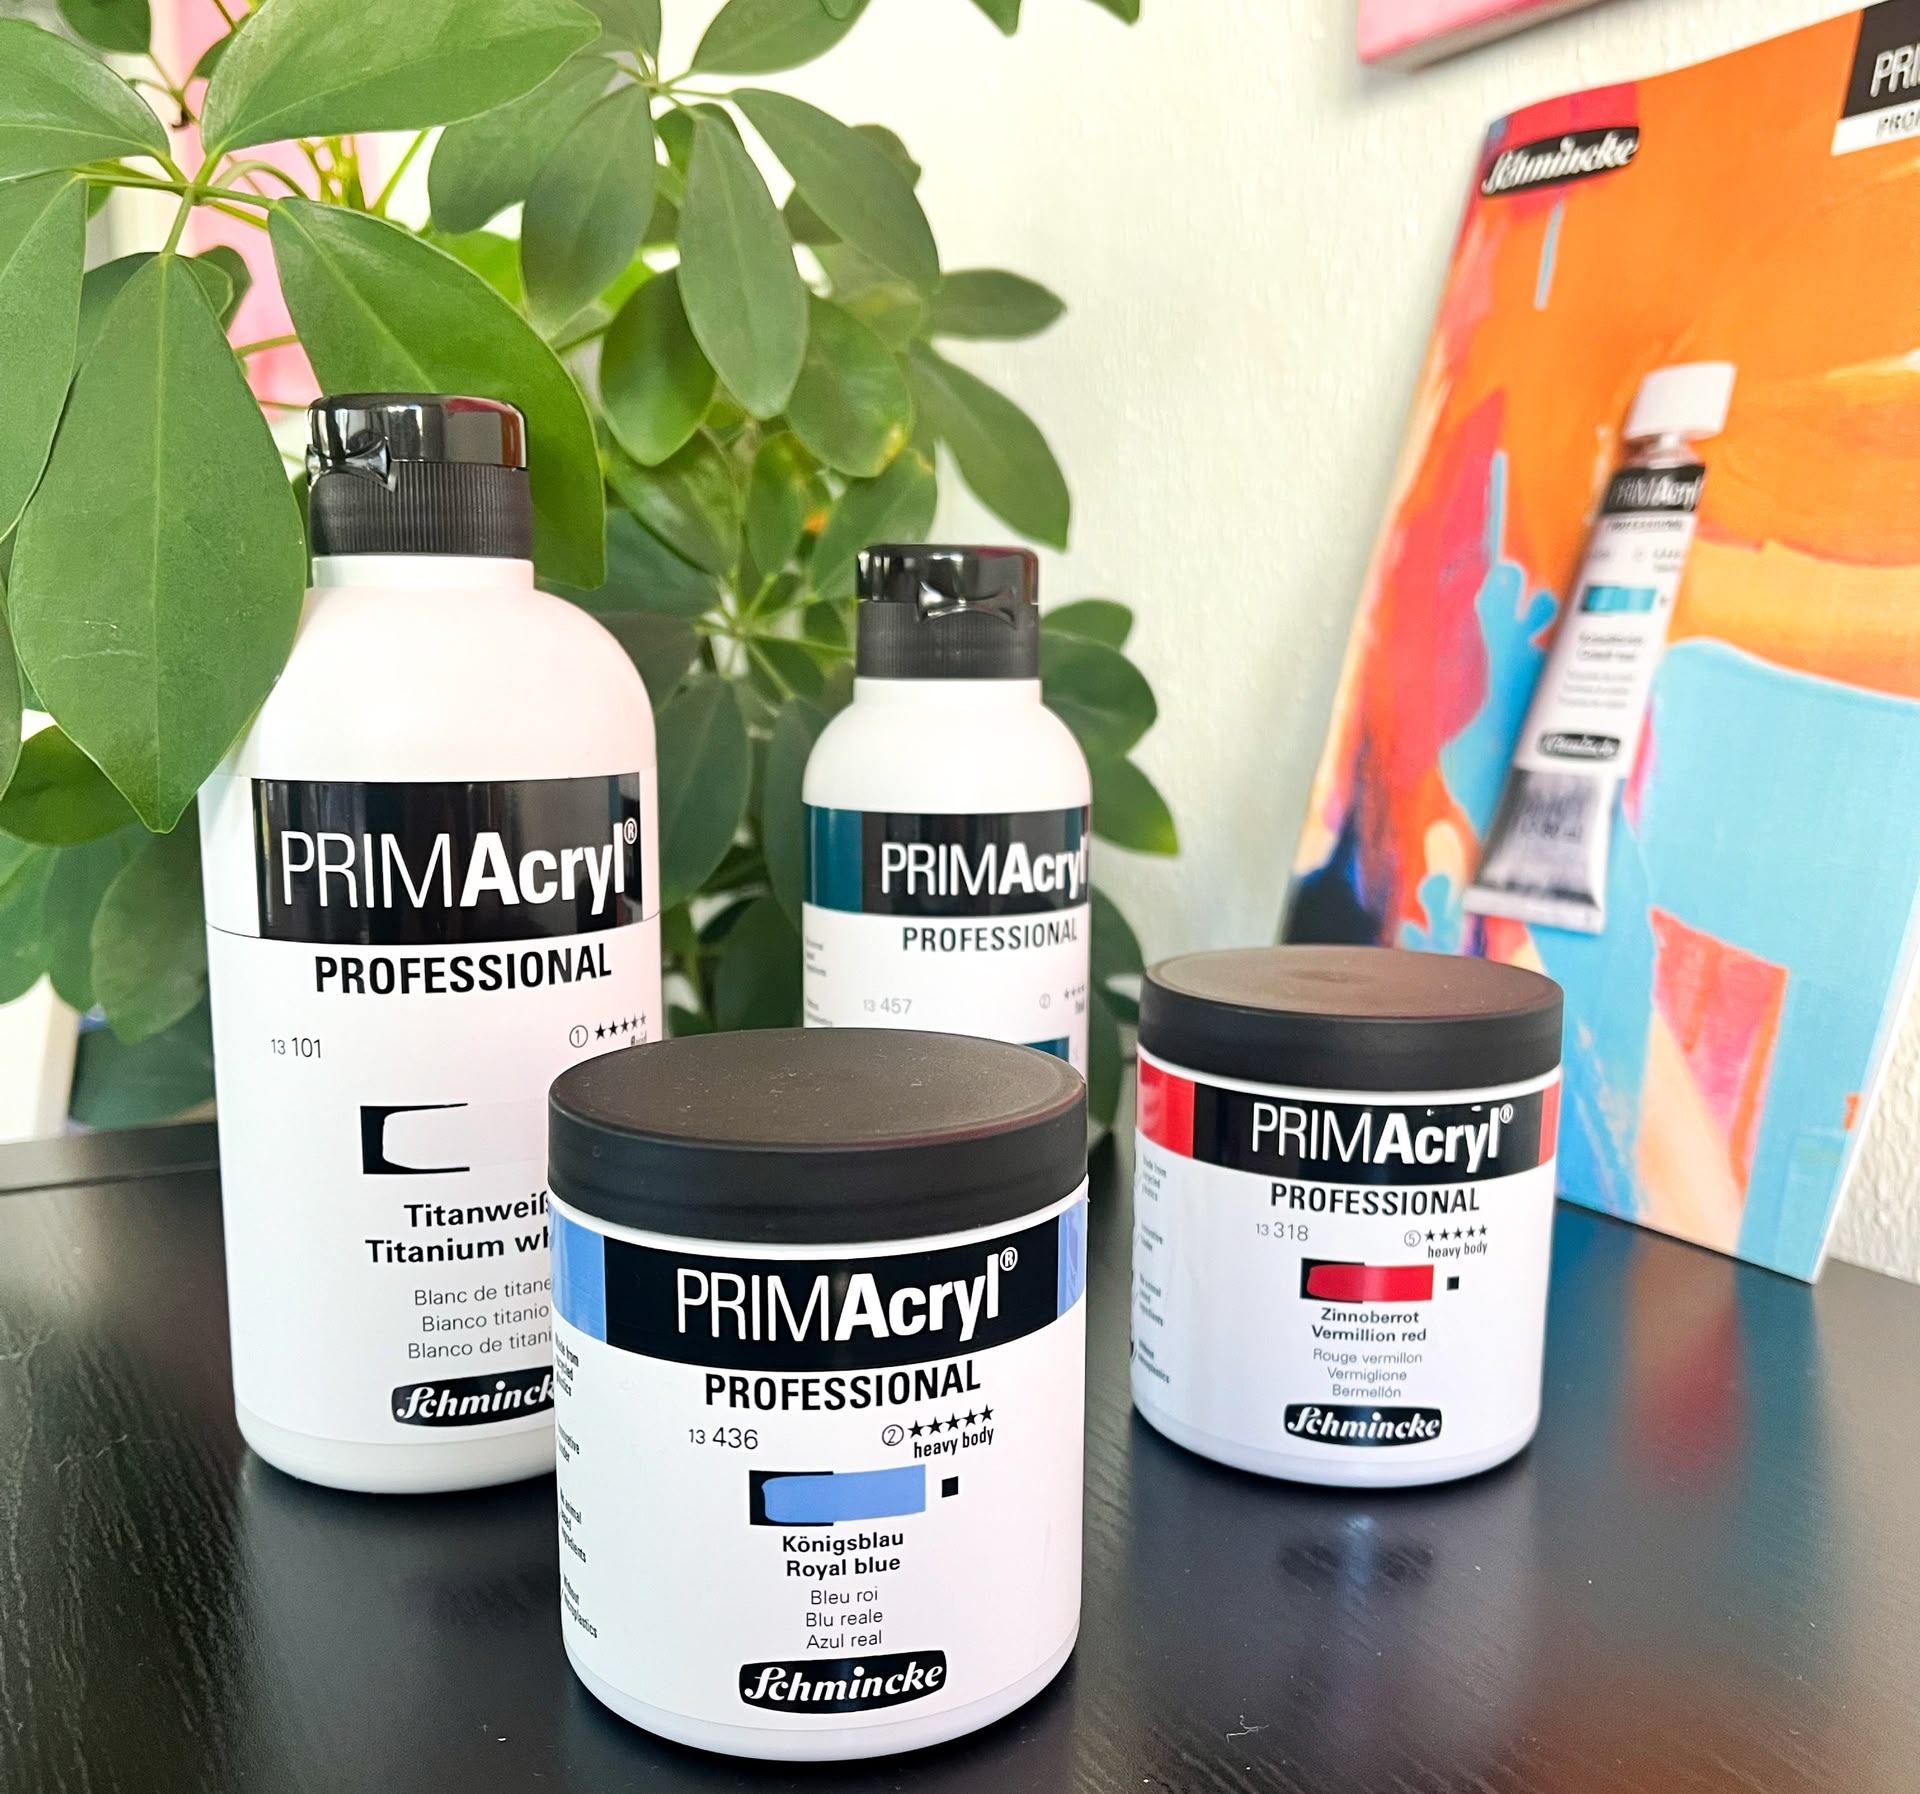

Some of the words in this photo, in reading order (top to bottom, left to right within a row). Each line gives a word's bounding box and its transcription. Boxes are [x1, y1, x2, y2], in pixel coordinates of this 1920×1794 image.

[881, 835, 1088, 899] PRIMAcryl
[902, 918, 1078, 951] PROFESSIONAL
[314, 943, 612, 994] PROFESSIONAL
[880, 998, 913, 1015] 457
[270, 1039, 286, 1055] 13
[291, 1037, 322, 1059] 101
[1271, 1182, 1480, 1216] PROFESSIONAL
[1255, 1223, 1269, 1236] 13
[1273, 1222, 1309, 1242] 318
[365, 1236, 505, 1263] Titanium
[1427, 1244, 1461, 1260] heavy
[1464, 1241, 1488, 1256] body
[414, 1289, 468, 1306] Blanc
[474, 1285, 497, 1302] de
[504, 1278, 551, 1298] titane
[422, 1315, 487, 1332] Bianco
[493, 1303, 549, 1326] titanio
[1320, 1307, 1420, 1324] Zinnoberrot
[1312, 1325, 1396, 1343] Vermillion
[1401, 1328, 1427, 1343] red
[408, 1342, 473, 1359] Blanco
[479, 1337, 502, 1353] de
[1313, 1348, 1357, 1365] Rouge
[1361, 1351, 1423, 1364] vermillon
[705, 1360, 981, 1410] PROFESSIONAL
[1327, 1367, 1408, 1383] Vermiglione
[1332, 1383, 1402, 1399] Bermellón
[1287, 1406, 1441, 1440] Schmincke
[688, 1429, 706, 1445] 13
[712, 1427, 759, 1450] 436
[913, 1437, 958, 1459] heavy
[962, 1426, 995, 1450] body
[782, 1531, 904, 1556] Königsblau
[786, 1559, 847, 1581] Royal
[854, 1556, 901, 1576] blue
[810, 1588, 849, 1606] Bleu
[856, 1586, 879, 1603] roi
[806, 1612, 836, 1628] Blu
[841, 1609, 884, 1627] reale
[806, 1633, 844, 1650] Azul
[850, 1630, 882, 1648] real
[745, 1660, 944, 1702] Schmincke
